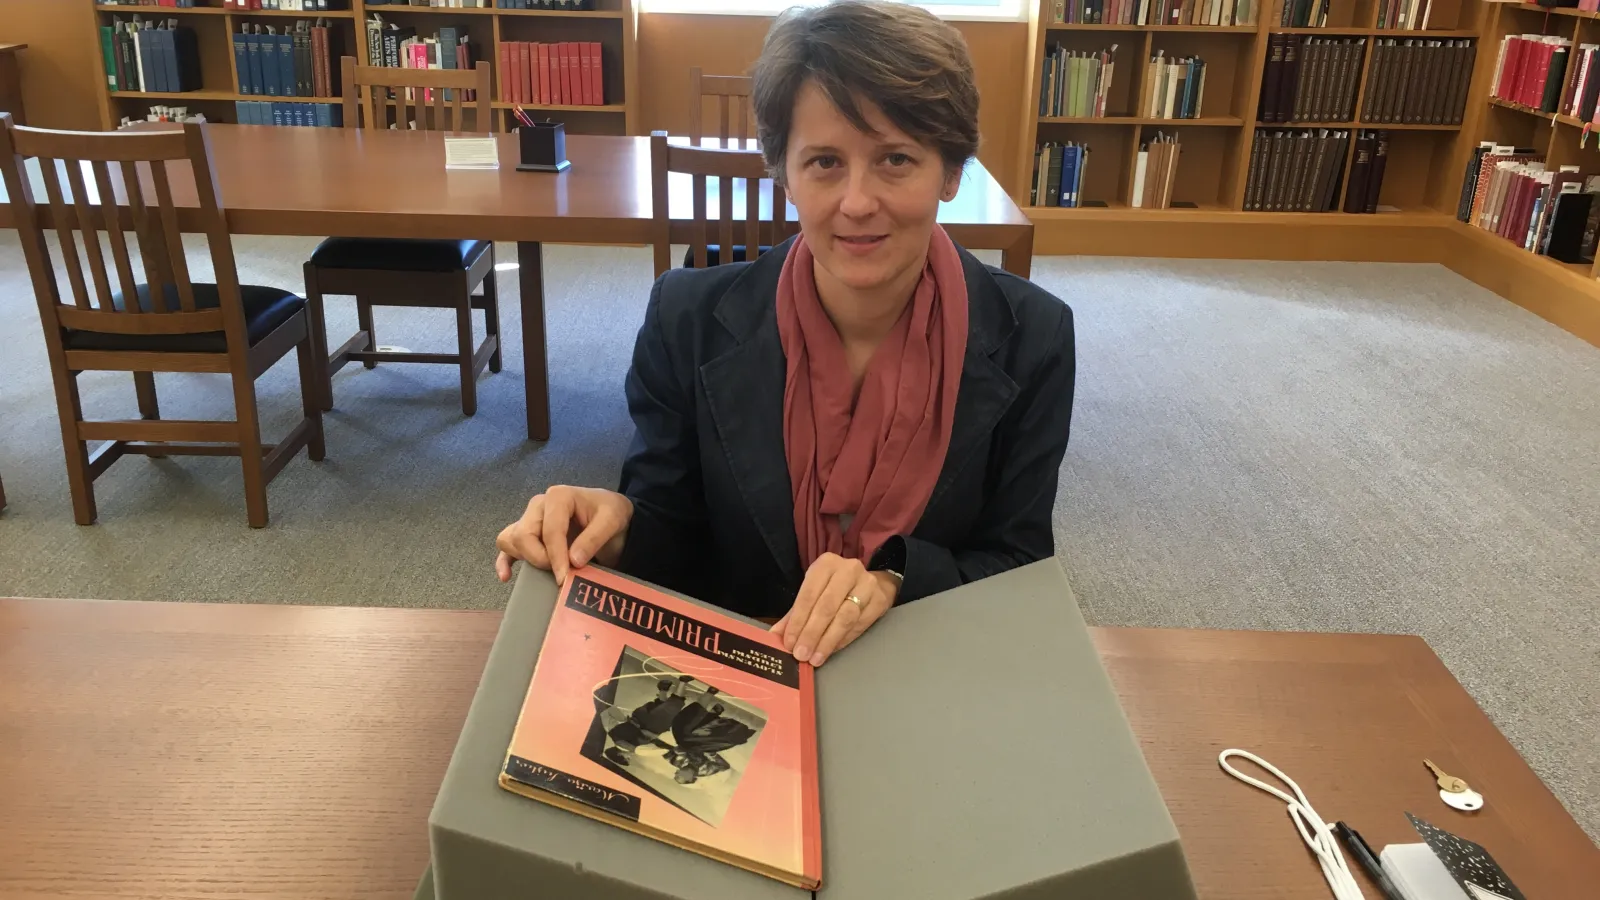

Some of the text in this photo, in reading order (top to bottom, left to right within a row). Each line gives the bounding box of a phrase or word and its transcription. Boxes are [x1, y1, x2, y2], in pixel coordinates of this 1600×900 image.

[574, 581, 720, 654] PRIMORSKE
[717, 650, 784, 676] SLOVENSKI
[749, 649, 783, 664] PLESI
